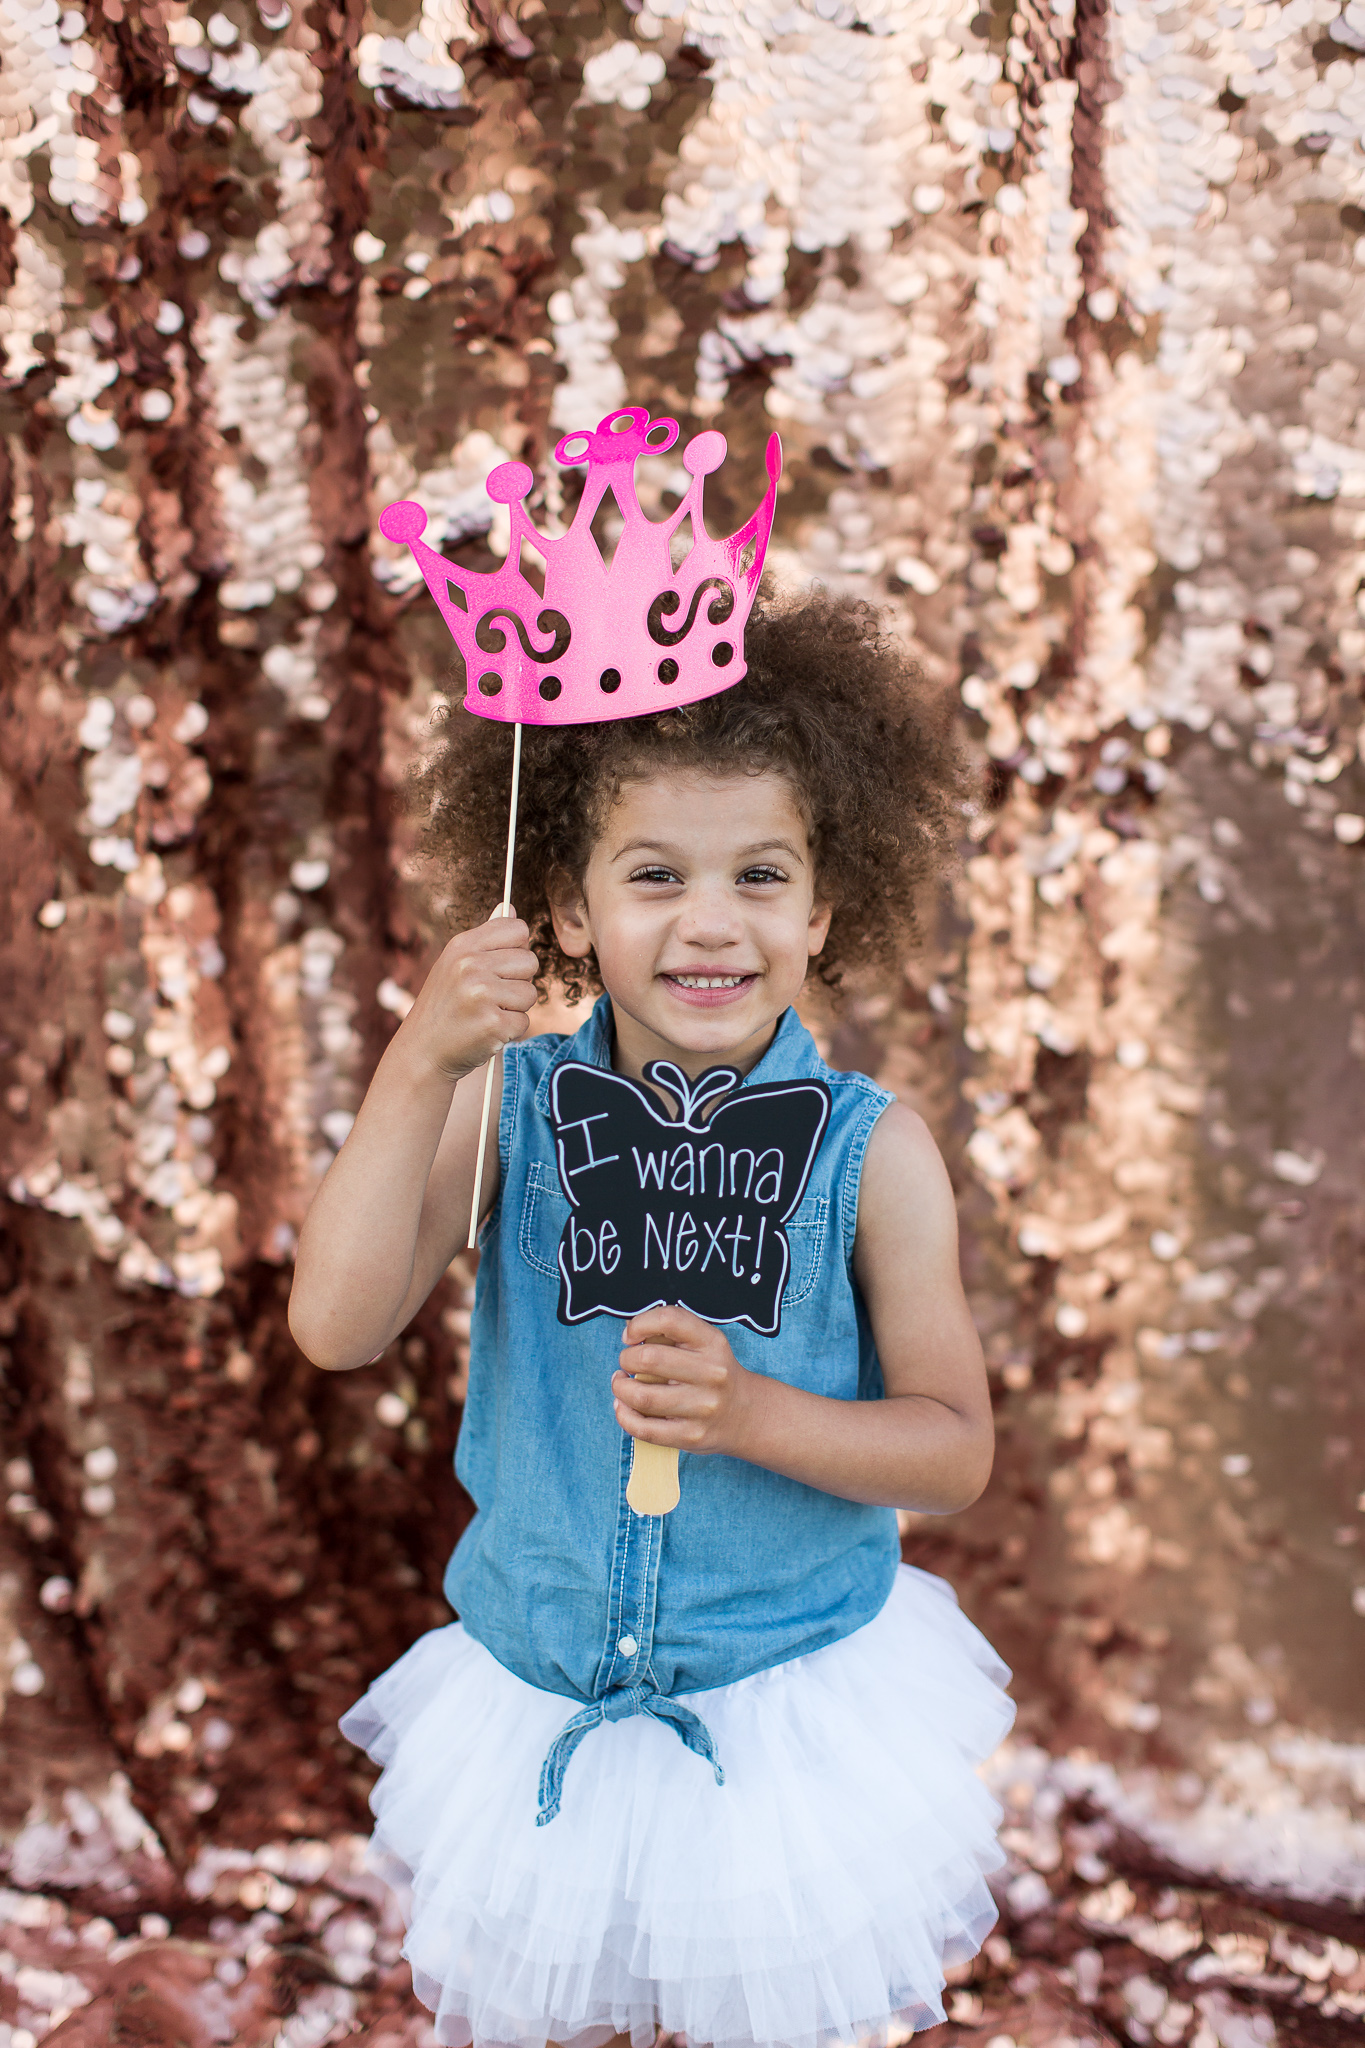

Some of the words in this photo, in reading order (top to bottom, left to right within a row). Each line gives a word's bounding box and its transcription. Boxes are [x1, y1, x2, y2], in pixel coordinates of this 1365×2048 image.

[556, 1112, 620, 1177] I
[632, 1142, 784, 1204] wanna
[570, 1216, 621, 1275] be
[643, 1211, 768, 1284] Next!
